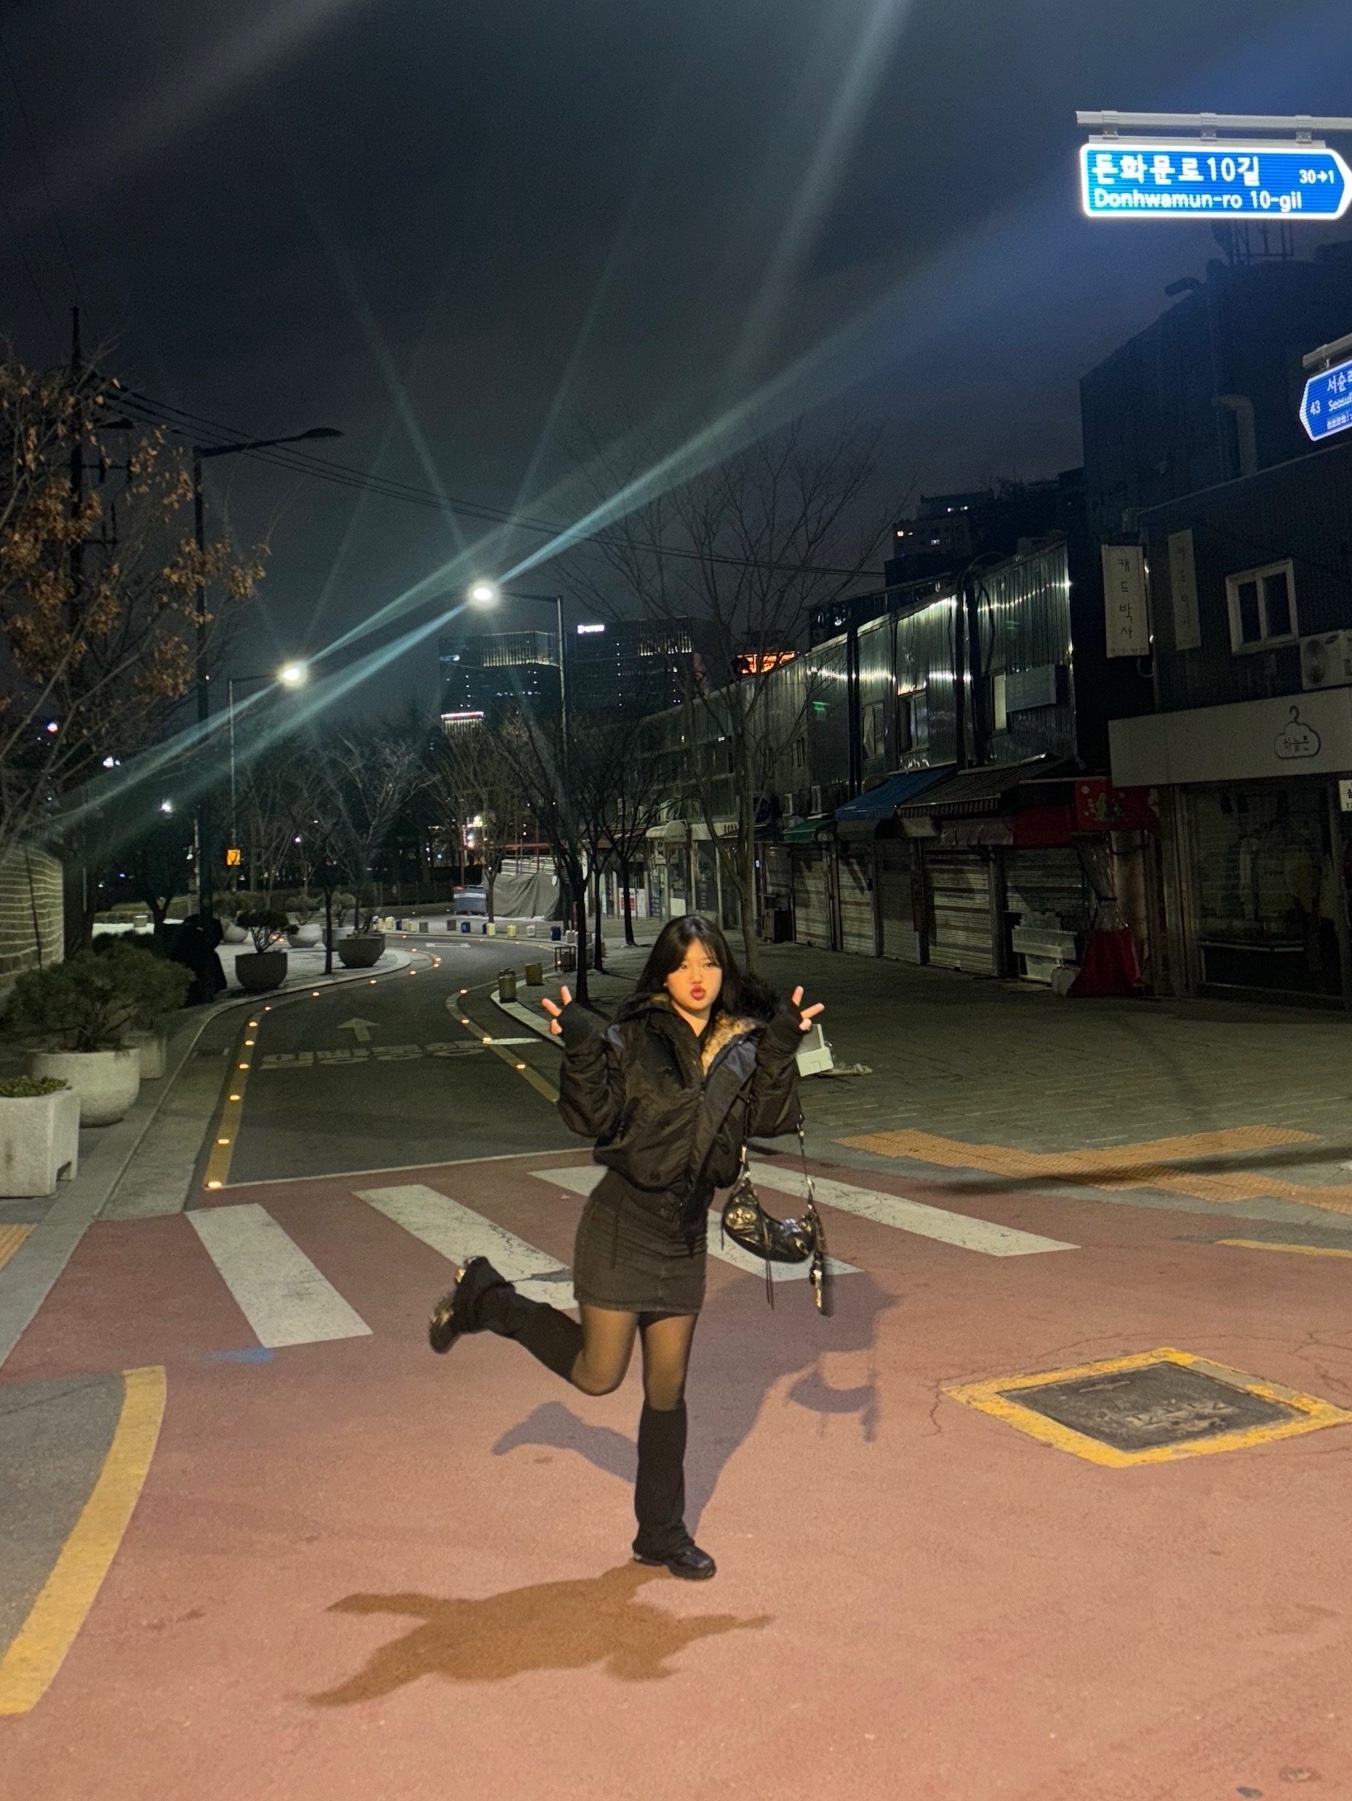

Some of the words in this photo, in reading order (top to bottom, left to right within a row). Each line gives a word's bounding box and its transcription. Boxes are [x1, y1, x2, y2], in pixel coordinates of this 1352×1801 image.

[1092, 154, 1260, 186] 돈화문로10길
[1299, 170, 1315, 184] 30
[1094, 188, 1242, 209] Donhwamun-ro
[1250, 191, 1302, 213] 10-gil
[1310, 400, 1321, 415] 43
[1117, 558, 1134, 640] 캐드박사
